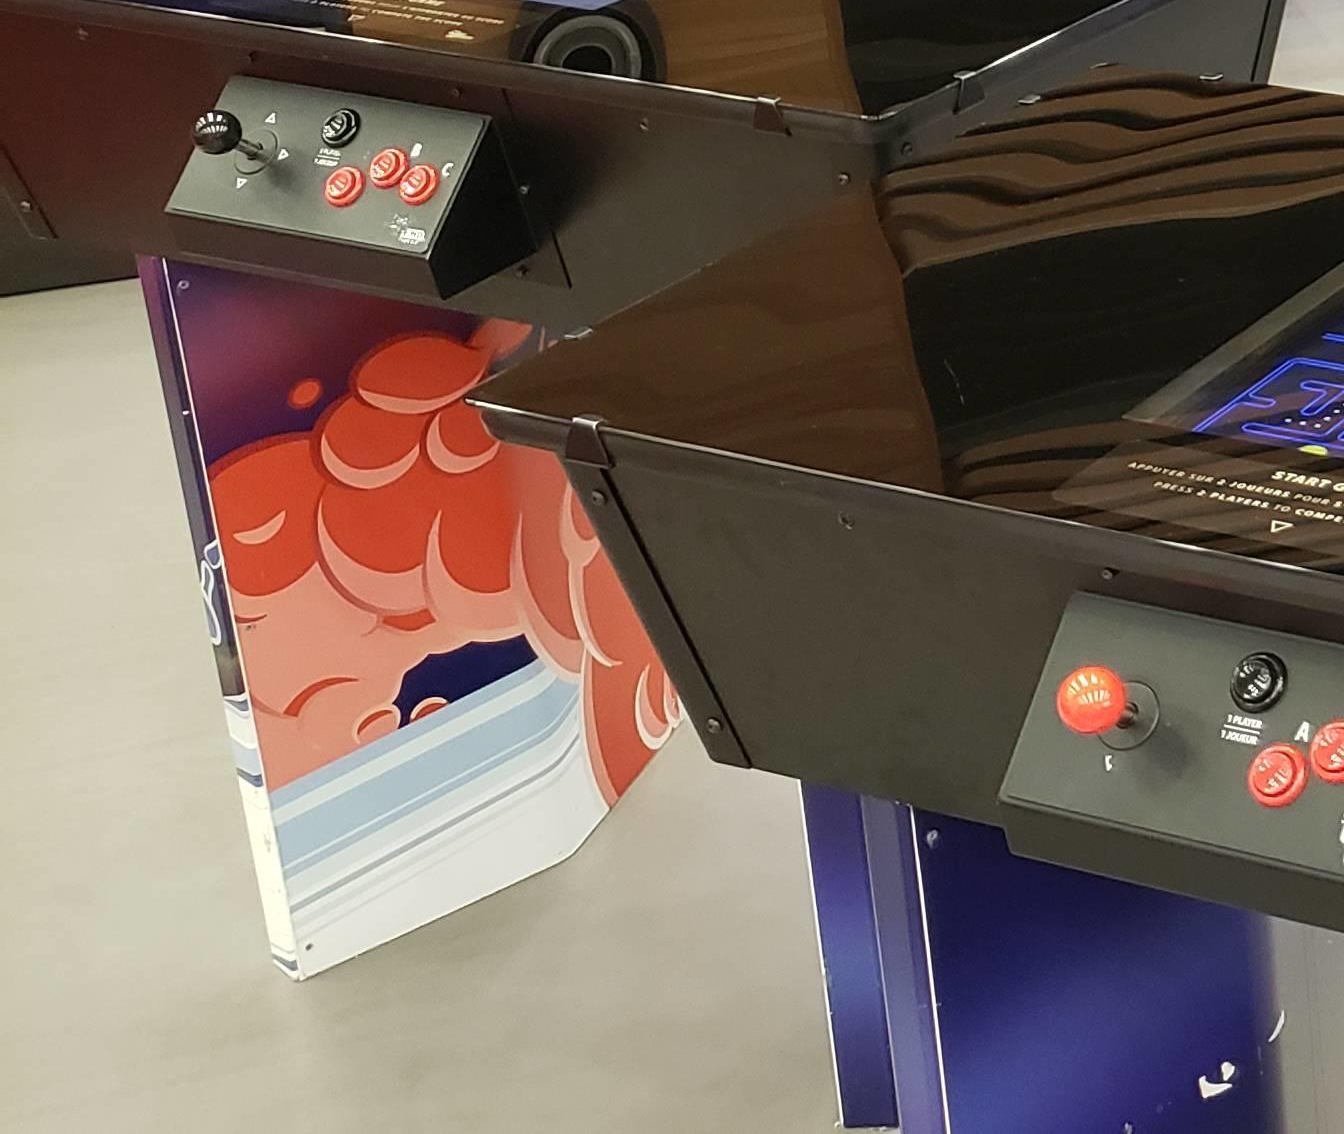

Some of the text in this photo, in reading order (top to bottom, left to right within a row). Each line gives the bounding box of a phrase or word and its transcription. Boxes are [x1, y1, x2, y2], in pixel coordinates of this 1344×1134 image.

[410, 143, 423, 158] B
[441, 162, 455, 178] C
[1127, 461, 1187, 480] APPUYER
[1188, 472, 1215, 484] SUR
[1216, 478, 1228, 487] 2
[1228, 480, 1292, 499] JOUEURS
[1293, 492, 1330, 506] POUR
[1271, 470, 1332, 490] START
[1153, 480, 1194, 495] PRESS
[1196, 488, 1207, 497] 2
[1209, 491, 1269, 510] PLAYERS
[1272, 502, 1292, 514] TO
[1232, 715, 1264, 729] PLAYER
[1226, 730, 1259, 745] JOUEUR
[1294, 721, 1311, 743] A
